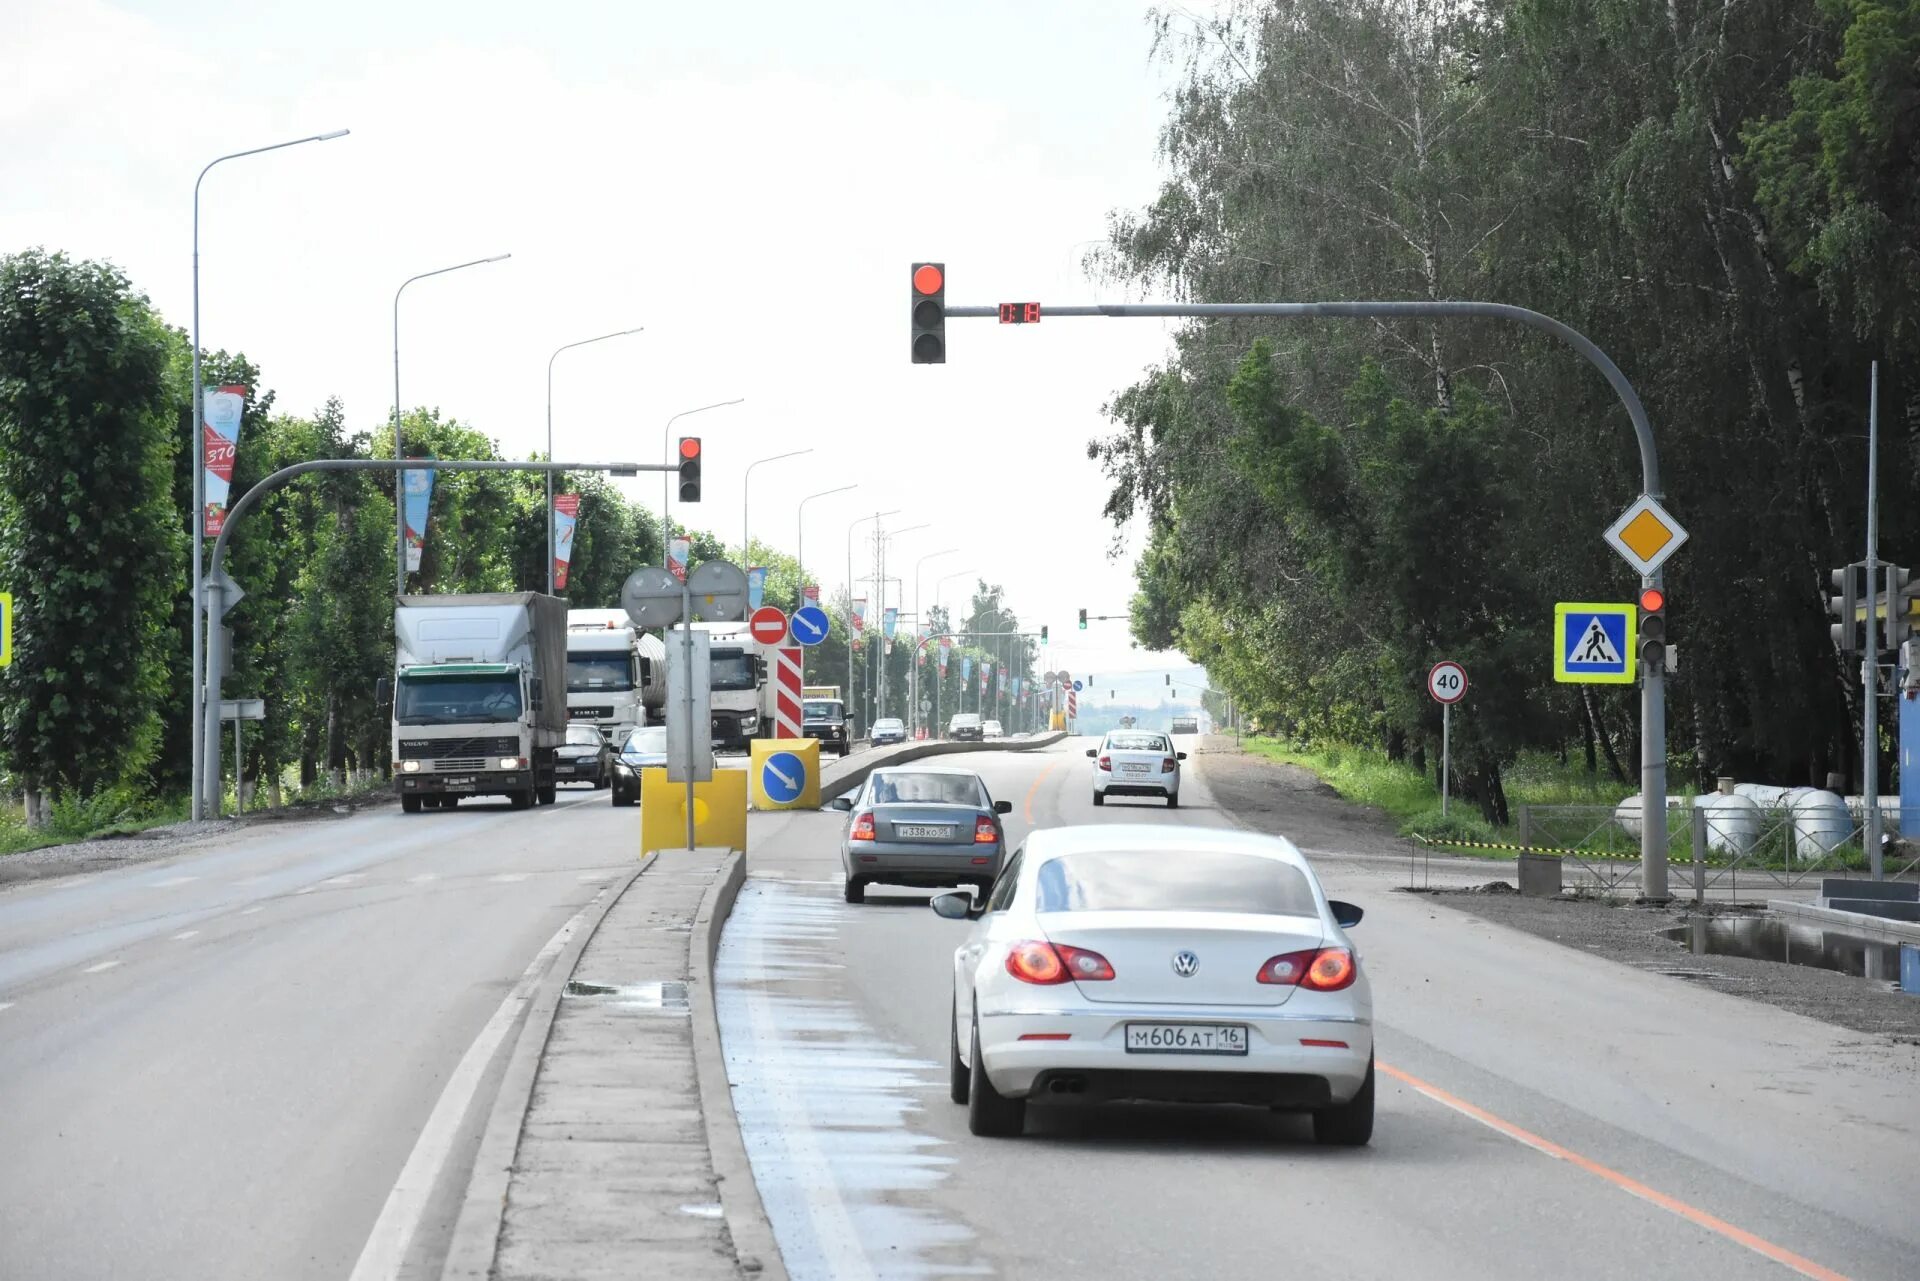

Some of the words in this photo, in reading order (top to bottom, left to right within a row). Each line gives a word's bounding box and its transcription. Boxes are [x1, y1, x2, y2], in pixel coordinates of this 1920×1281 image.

[206, 444, 236, 464] 370
[1437, 674, 1459, 690] 40
[1135, 1028, 1214, 1046] М606АТ
[1220, 1028, 1238, 1042] 16
